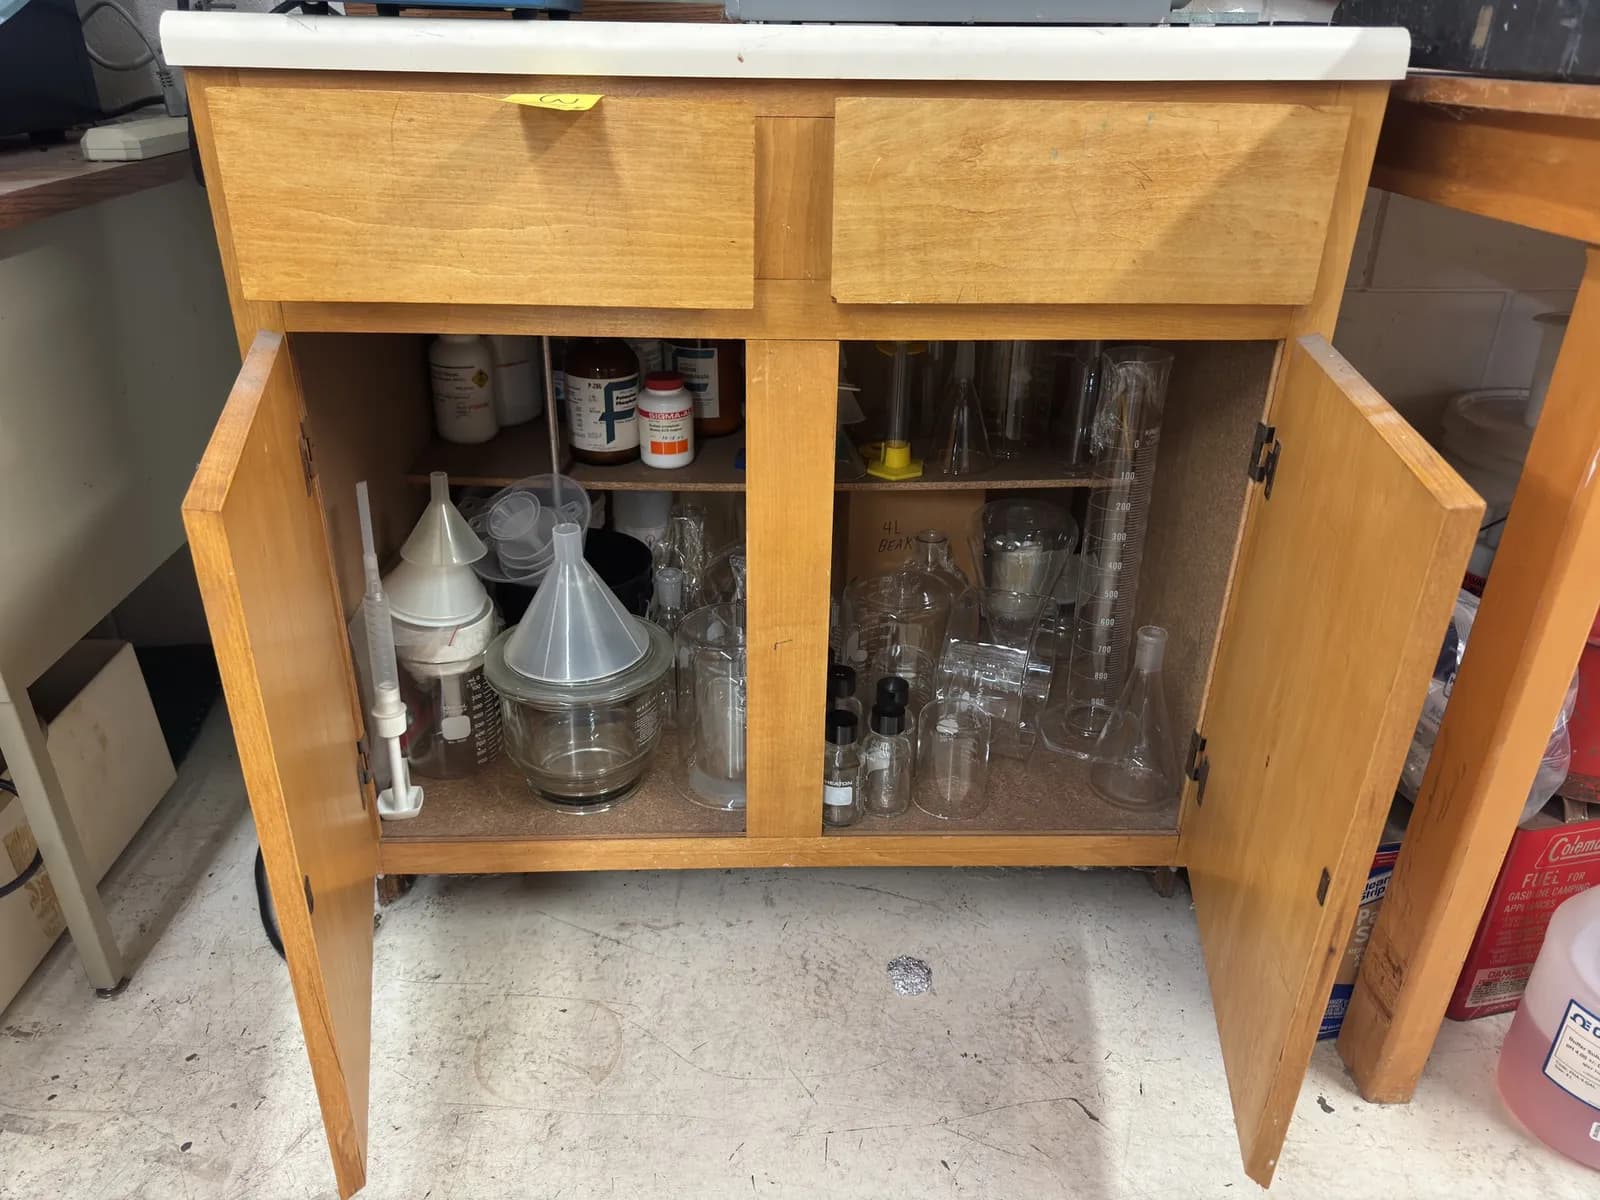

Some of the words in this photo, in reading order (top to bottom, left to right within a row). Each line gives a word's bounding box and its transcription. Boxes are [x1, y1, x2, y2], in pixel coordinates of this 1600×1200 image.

[1121, 471, 1135, 481] 100
[1115, 502, 1131, 511] 200
[1111, 533, 1127, 541] 300
[1108, 561, 1123, 570] 400
[1103, 590, 1119, 599] 500
[1100, 618, 1115, 627] 600
[1097, 645, 1112, 654] 700
[1566, 871, 1586, 882] FOR
[1365, 876, 1391, 891] lean
